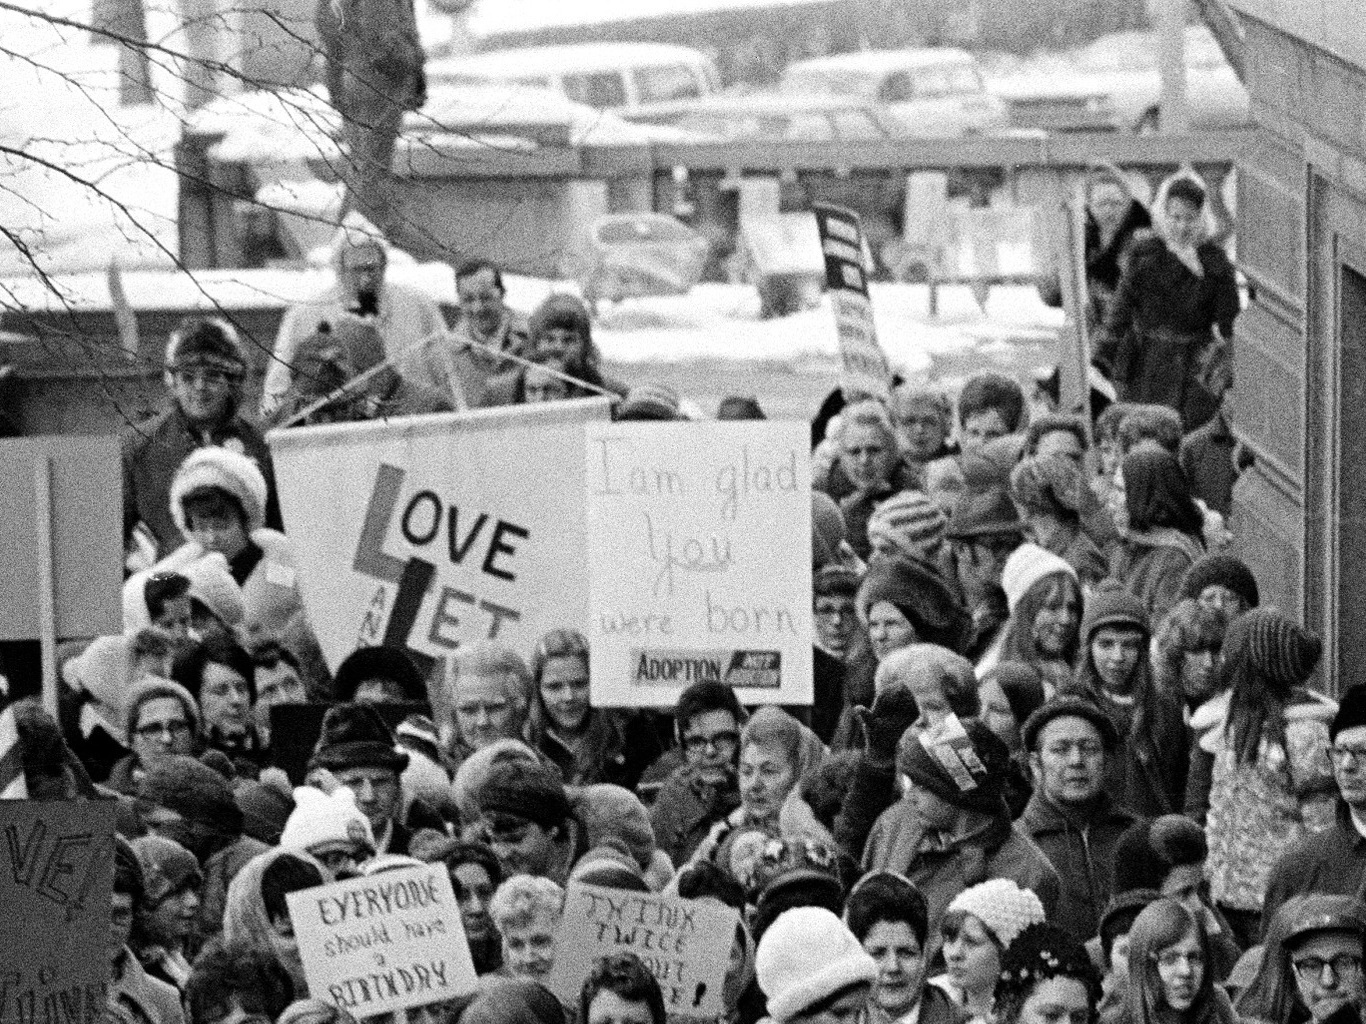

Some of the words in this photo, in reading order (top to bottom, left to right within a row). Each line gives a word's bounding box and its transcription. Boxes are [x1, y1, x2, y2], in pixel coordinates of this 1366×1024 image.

[716, 447, 797, 520] glad
[353, 463, 530, 582] LOVE
[601, 614, 672, 635] were
[706, 589, 800, 637] born
[317, 874, 441, 926] EVERYONE
[323, 920, 394, 958] should
[402, 917, 447, 942] have
[372, 952, 386, 968] a
[597, 922, 688, 952] TWICE
[329, 960, 449, 1008] BIRTHDAY
